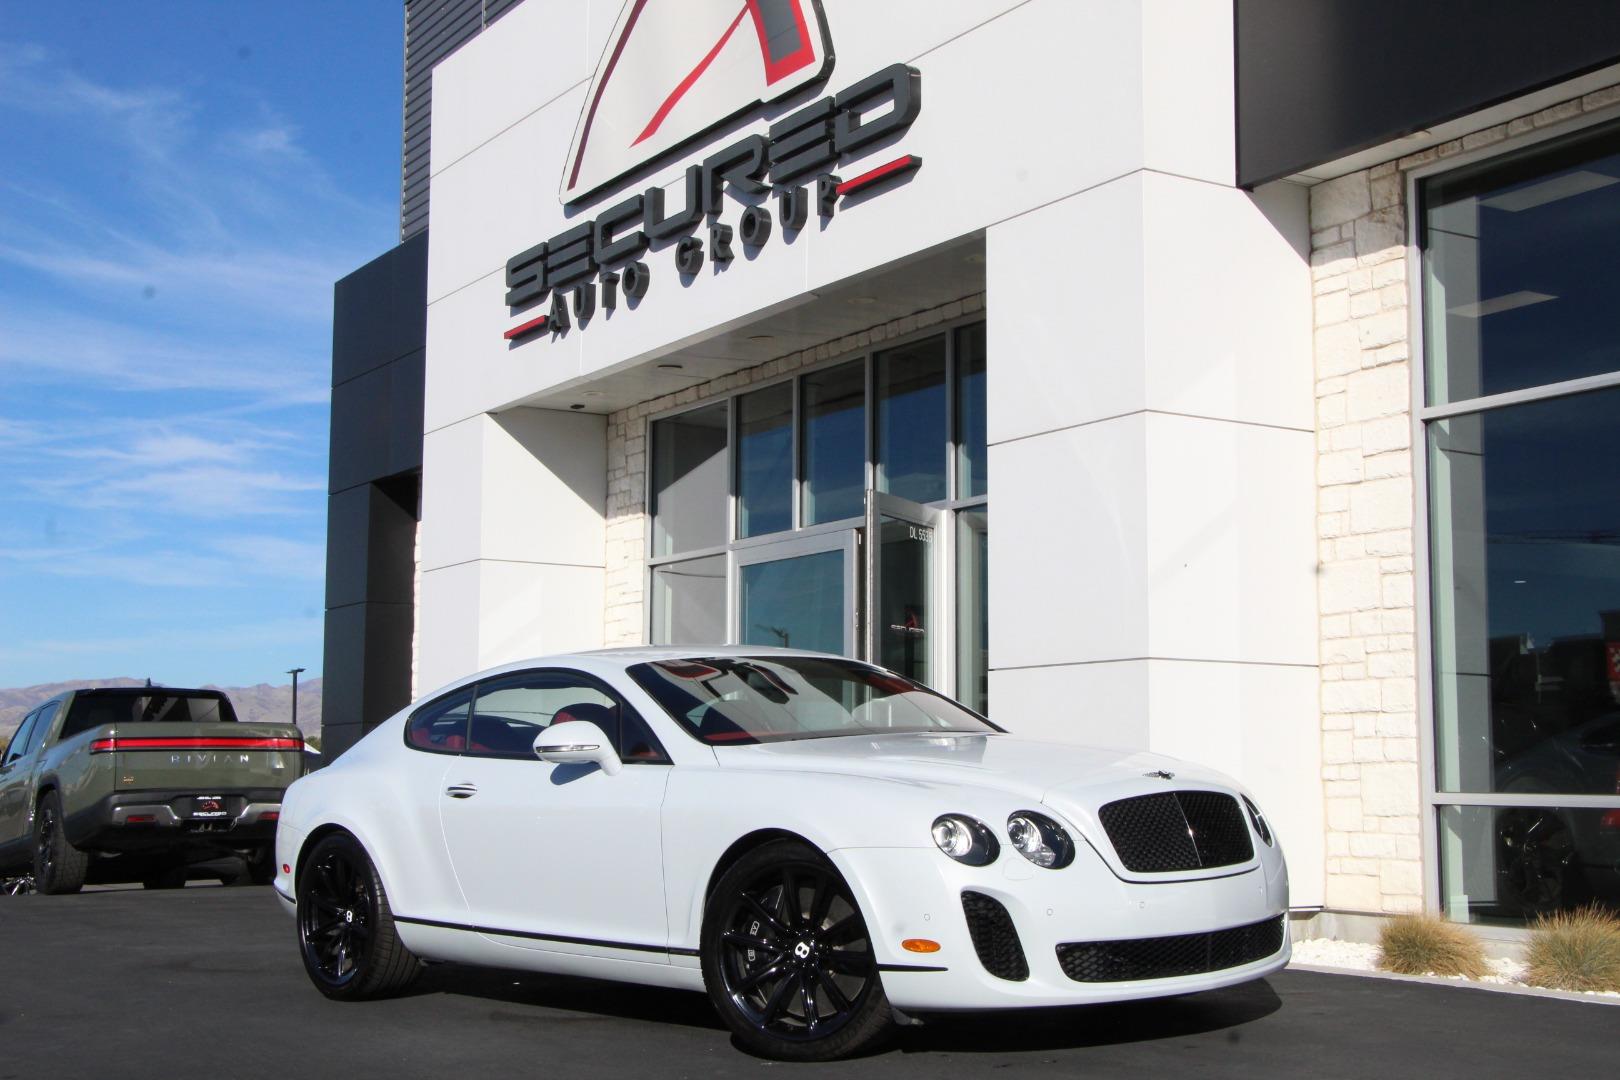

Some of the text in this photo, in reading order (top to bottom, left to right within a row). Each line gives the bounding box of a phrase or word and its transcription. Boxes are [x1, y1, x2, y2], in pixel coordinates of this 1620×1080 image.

[505, 63, 921, 306] SECURED
[547, 172, 843, 333] AUTO GROUP
[909, 526, 917, 540] DL
[171, 754, 249, 763] RIVIAN
